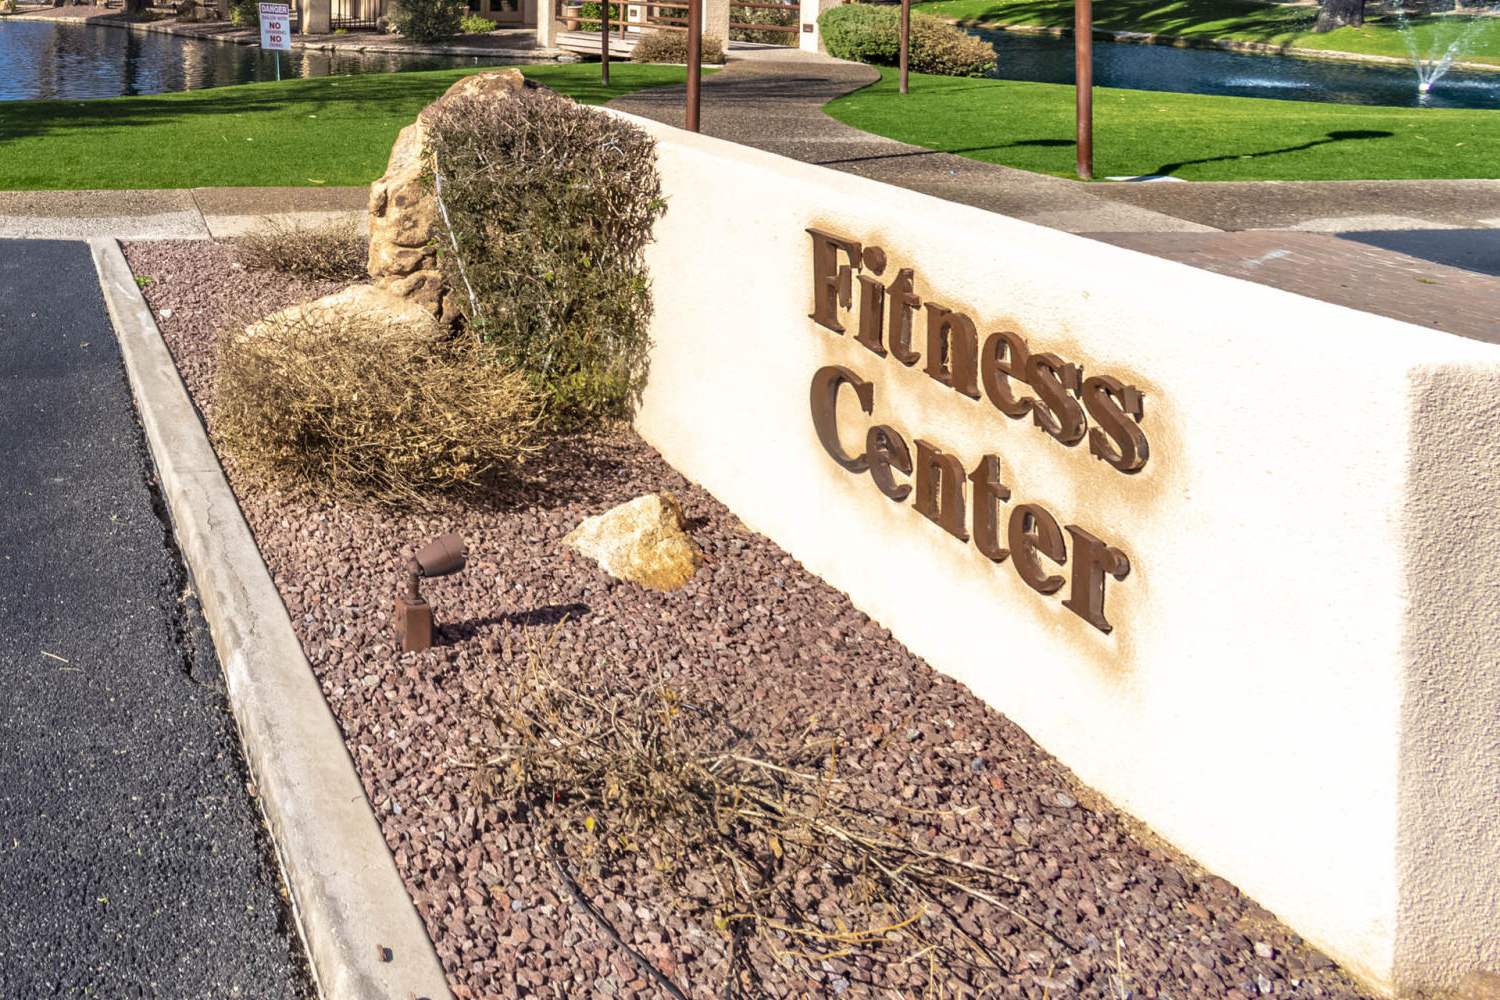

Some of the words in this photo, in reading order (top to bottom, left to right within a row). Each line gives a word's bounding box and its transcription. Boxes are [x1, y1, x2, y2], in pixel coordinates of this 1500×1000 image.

[261, 4, 287, 13] DANGER
[805, 228, 1149, 475] Fitness
[810, 365, 1131, 636] Center
